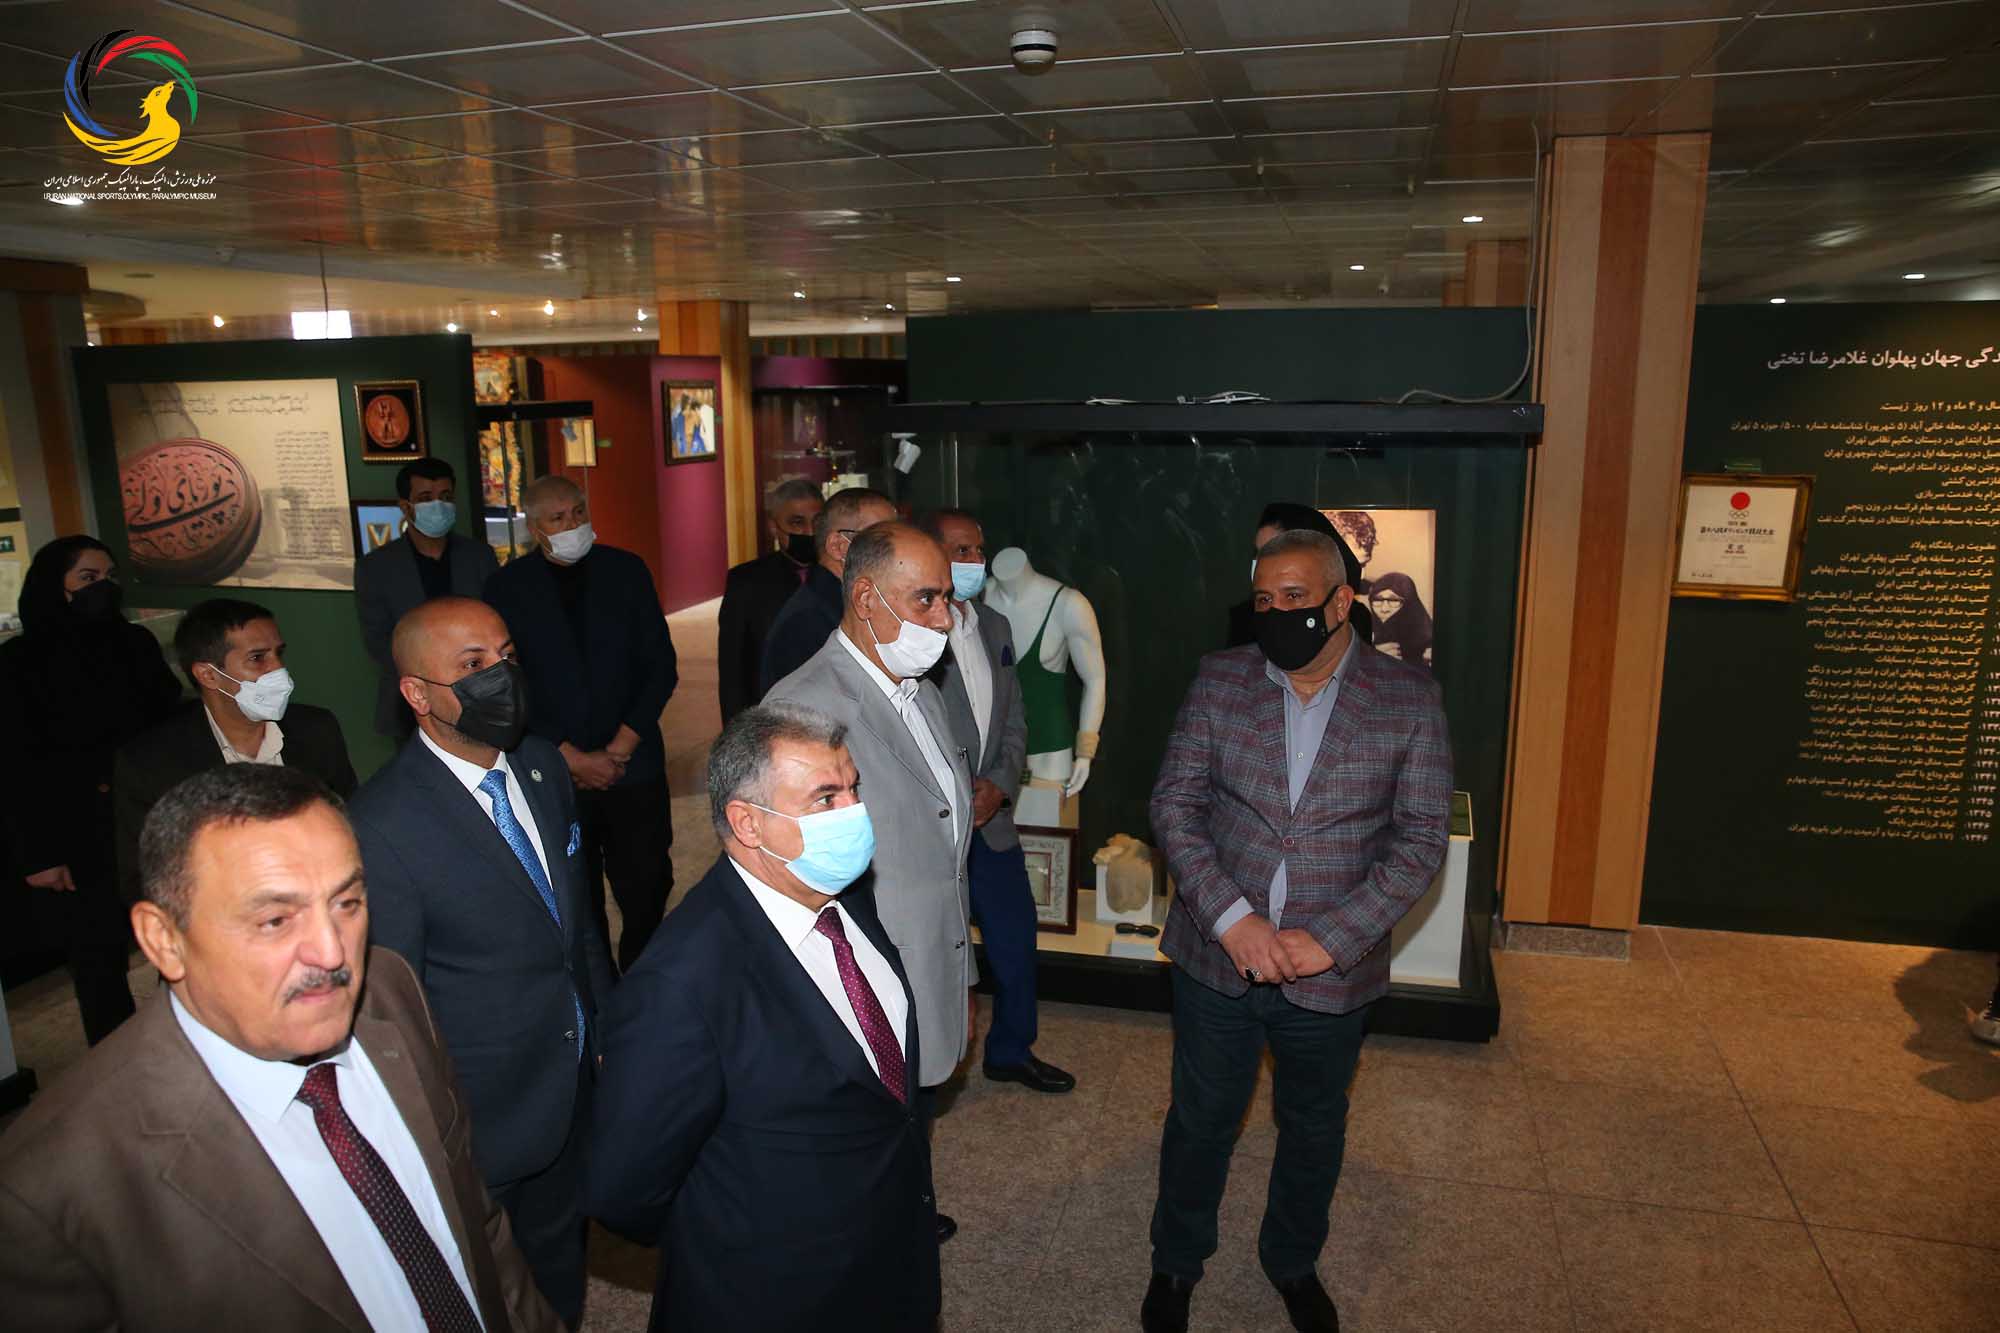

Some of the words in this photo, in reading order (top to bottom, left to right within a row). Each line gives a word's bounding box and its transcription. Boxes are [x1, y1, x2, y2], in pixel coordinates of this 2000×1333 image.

[1767, 351, 1806, 370] تختی
[1809, 350, 1868, 369] غلامرضا
[1871, 349, 1917, 370] پهلوان
[1921, 349, 1963, 368] جهان
[1964, 346, 2000, 369] دگی
[1913, 403, 1929, 412] روز
[1953, 401, 1967, 409] ماه
[1845, 436, 1867, 445] تهران
[1890, 436, 1913, 446] حکیم
[1914, 436, 1942, 445] دبستان
[1943, 436, 1954, 445] در
[1823, 449, 1844, 458] تهران
[1845, 450, 1877, 458] منوچهری
[1878, 450, 1911, 458] دبیرستان
[1911, 450, 1921, 458] در
[1921, 450, 1935, 458] اول
[1935, 450, 1963, 458] متوسطه
[1915, 463, 1936, 472] استاد
[1941, 477, 1966, 486] کشتی
[1914, 490, 1945, 499] سربازی
[1946, 491, 1973, 499] خدمت
[1935, 504, 1962, 512] مسابقه
[1962, 504, 1974, 512] در
[1839, 553, 1860, 562] تهران
[1888, 554, 1911, 563] کشتی
[1911, 555, 1928, 563] های
[1955, 555, 1967, 563] در
[1967, 555, 1995, 565] شرکت
